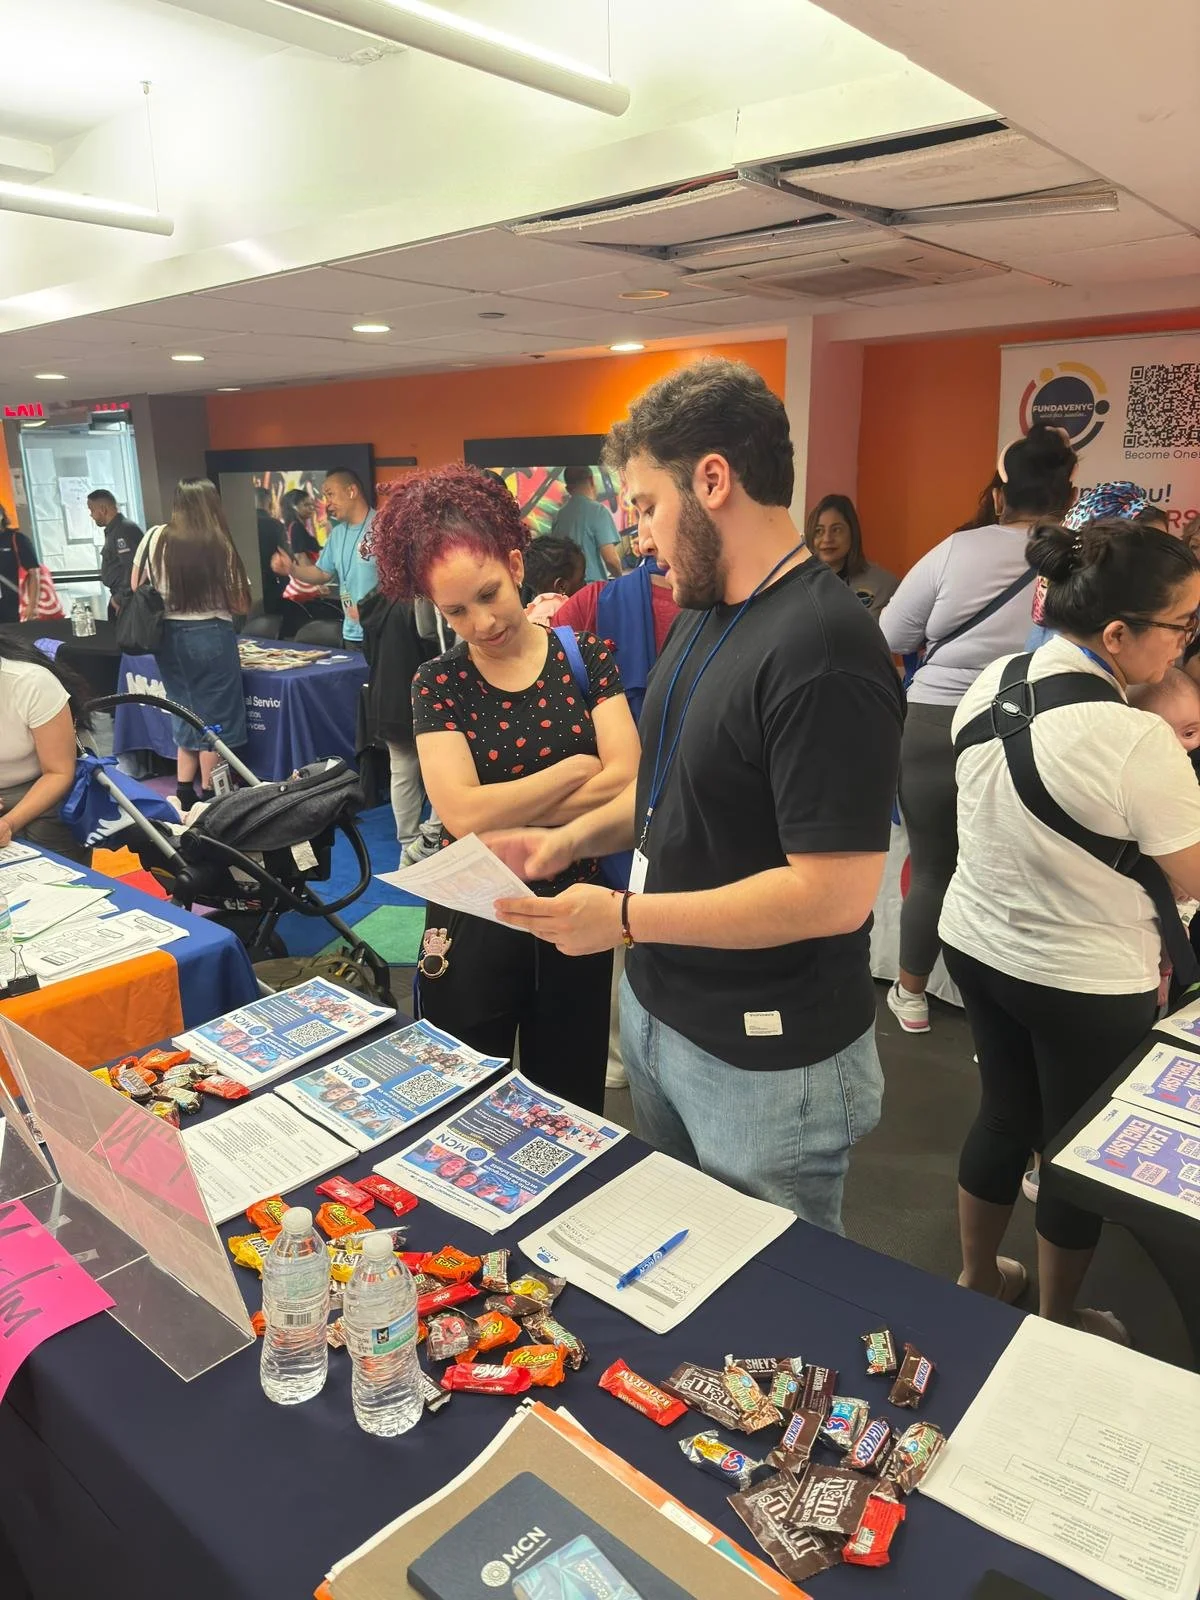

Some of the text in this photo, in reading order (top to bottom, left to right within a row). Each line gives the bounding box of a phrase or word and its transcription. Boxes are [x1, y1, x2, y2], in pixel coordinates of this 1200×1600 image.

[1032, 403, 1094, 412] FUNDAVENYC
[1124, 449, 1200, 460] Become One
[227, 1013, 255, 1028] MCN
[331, 1064, 356, 1081] MCN
[436, 1132, 470, 1152] MCN
[746, 1357, 777, 1370] SHEY'S
[783, 1413, 804, 1449] SNICKERS
[502, 1526, 546, 1565] MCN
